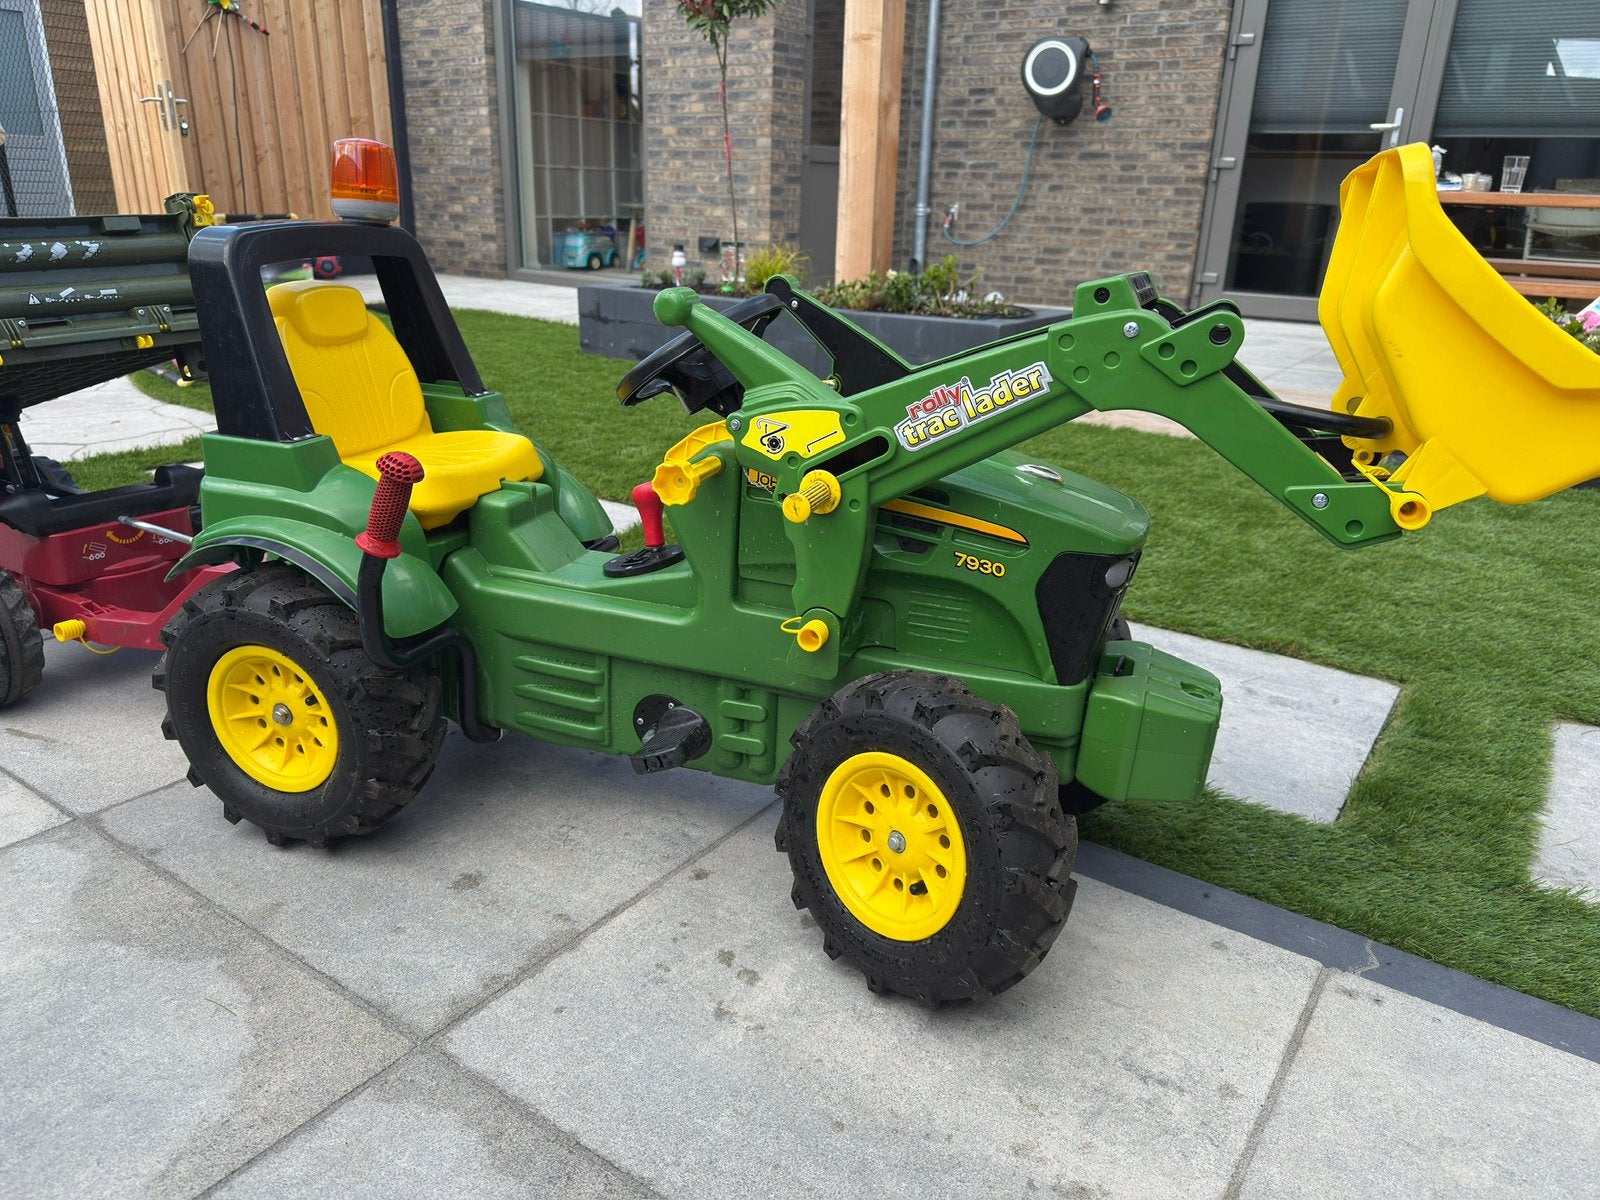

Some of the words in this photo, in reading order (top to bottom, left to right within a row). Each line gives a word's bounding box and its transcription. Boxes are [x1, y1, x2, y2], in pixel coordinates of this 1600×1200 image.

[903, 408, 960, 446] trac
[962, 369, 1042, 420] lader
[953, 551, 1007, 578] 7930
